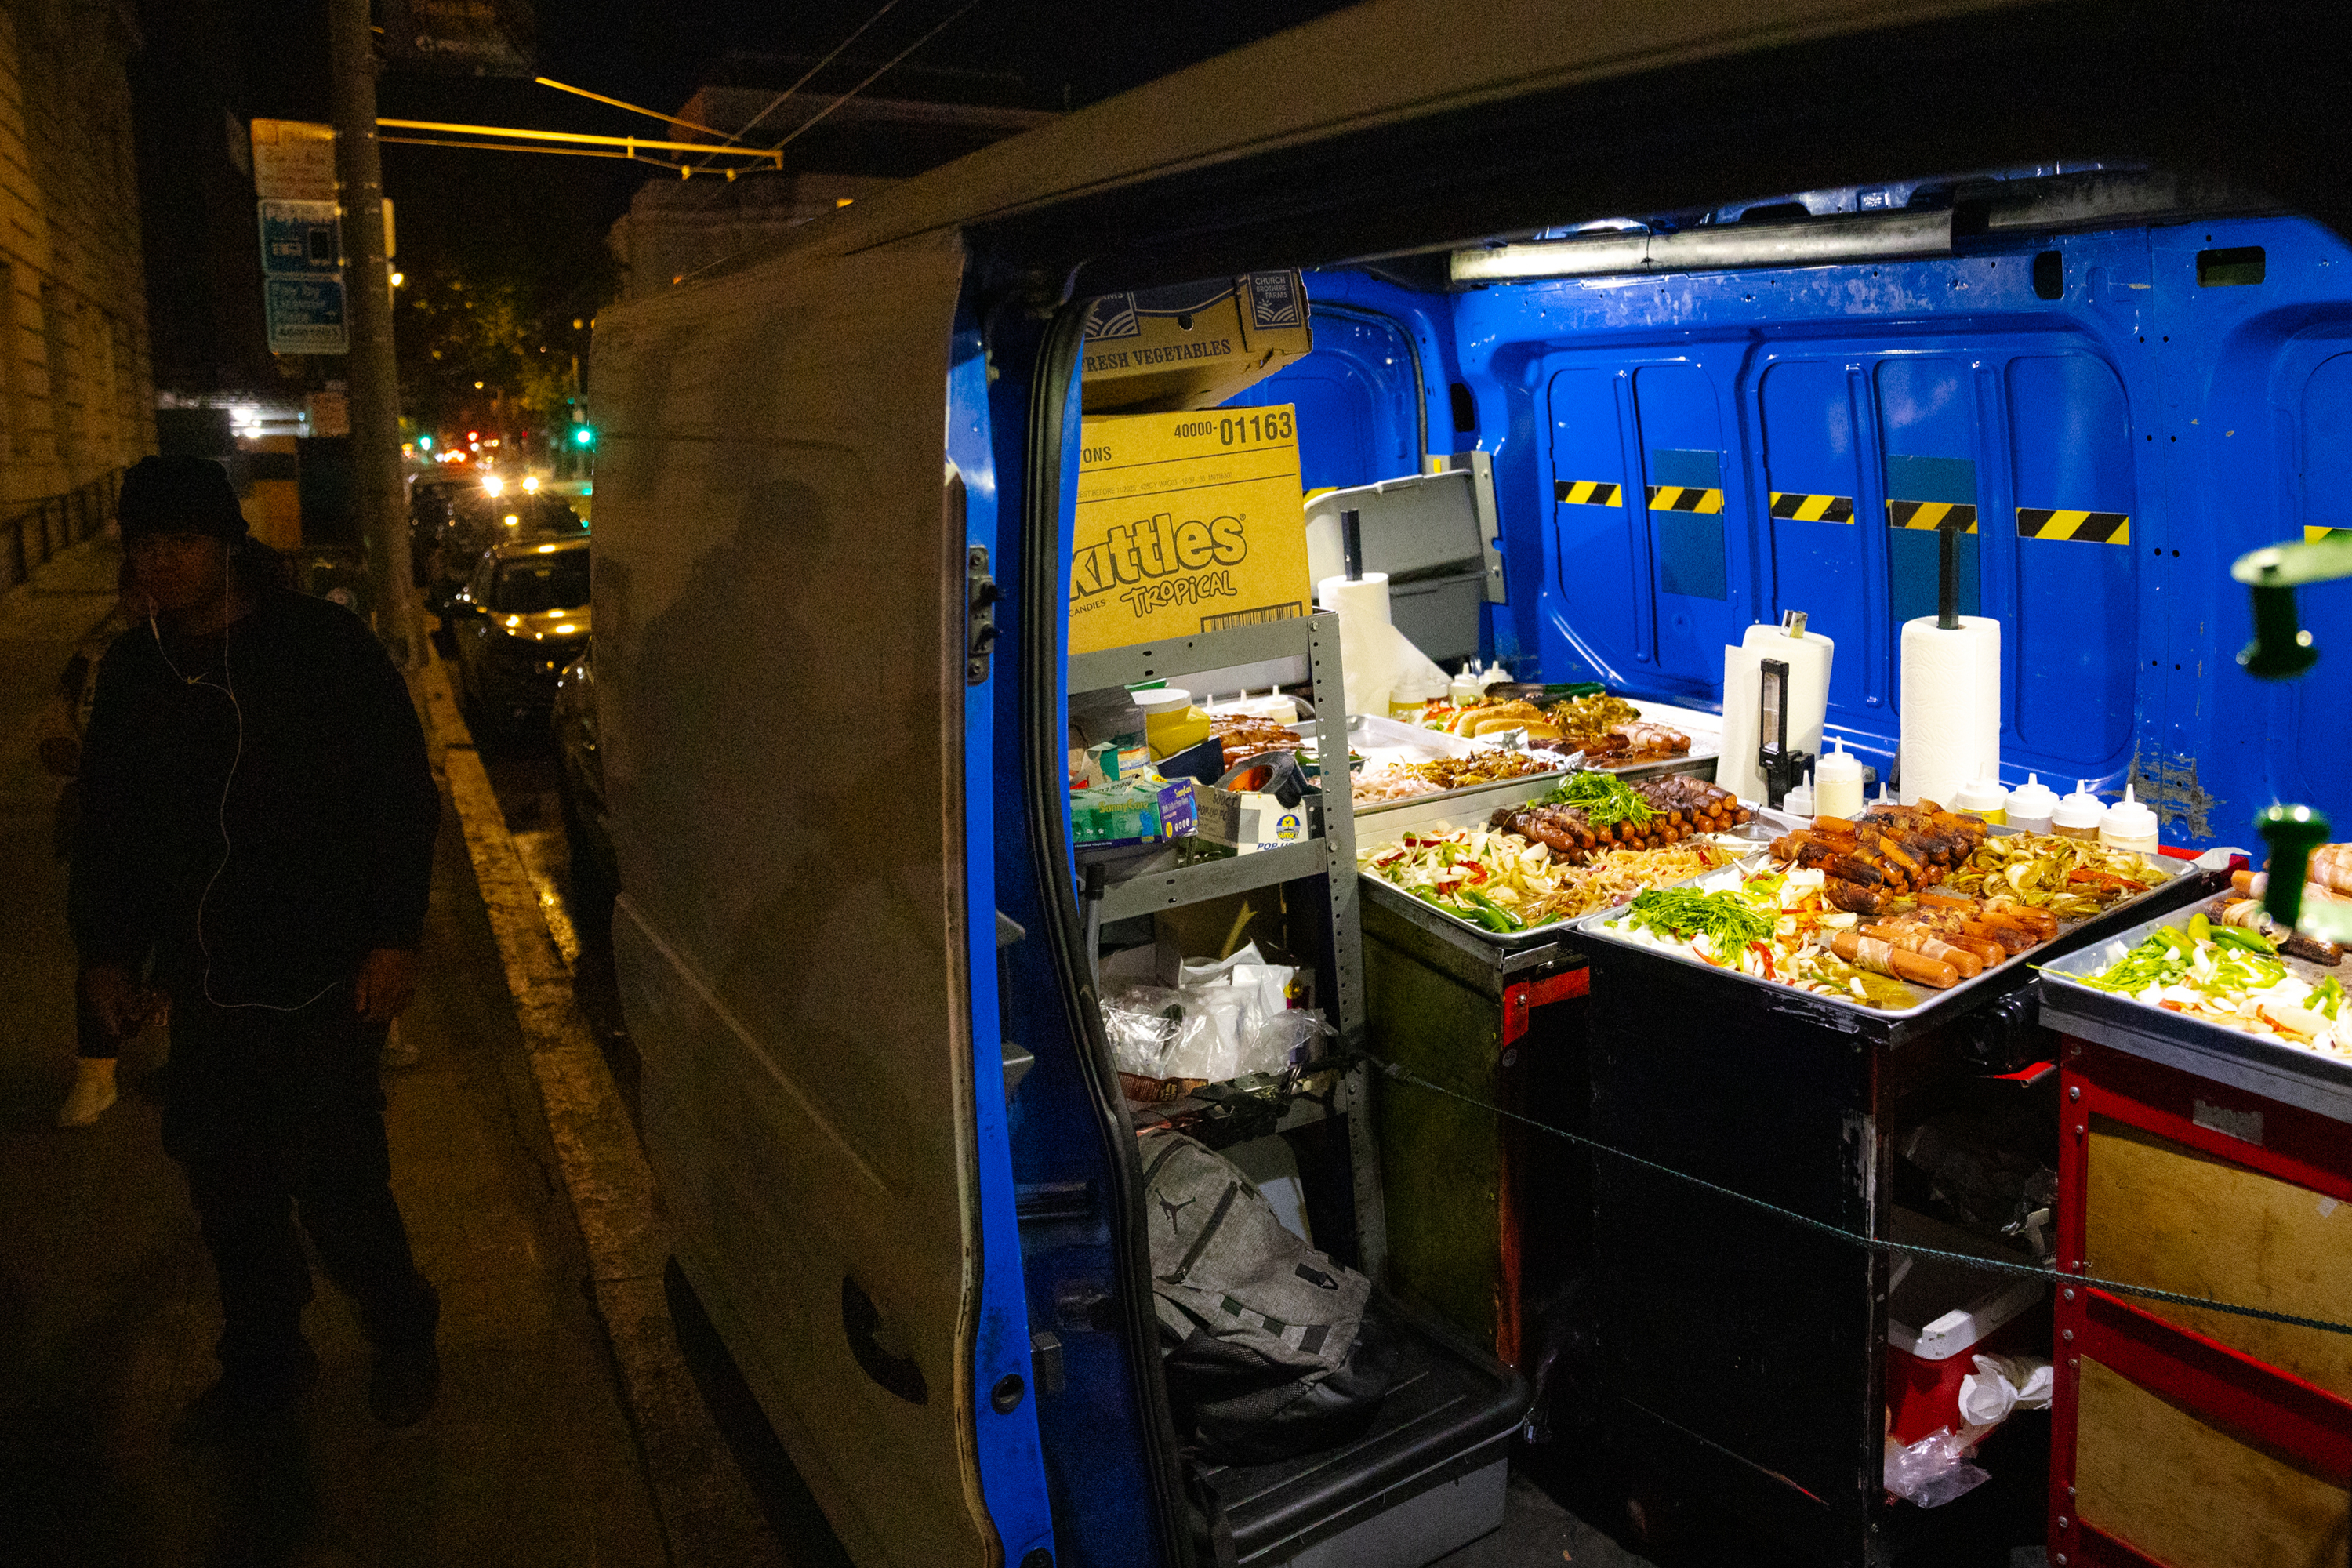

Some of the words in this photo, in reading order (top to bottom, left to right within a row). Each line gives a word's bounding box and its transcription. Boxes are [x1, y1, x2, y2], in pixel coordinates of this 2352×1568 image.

[1254, 276, 1286, 285] CHURCH
[1132, 339, 1232, 366] VEGETABLES
[1080, 446, 1112, 463] ONS
[1092, 487, 1114, 496] BEFORE
[1069, 599, 1105, 617] CANDIES
[1098, 798, 1149, 814] SunnyCare
